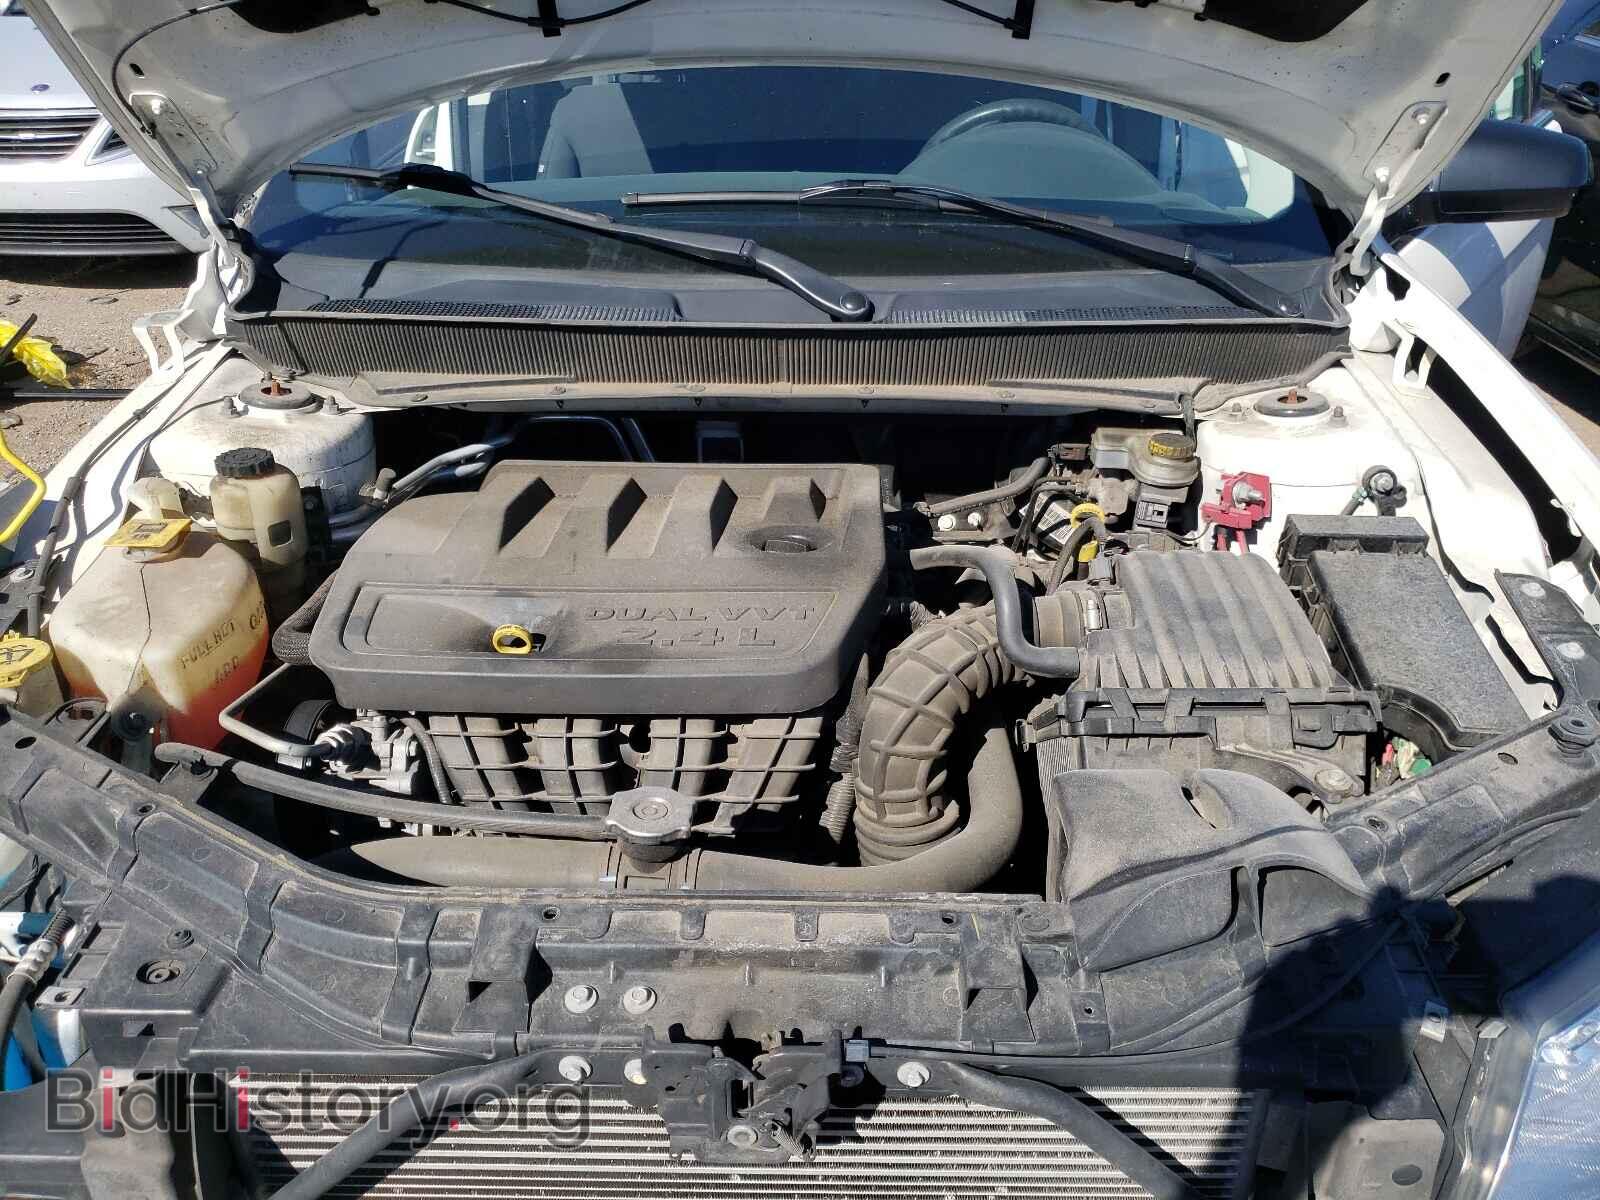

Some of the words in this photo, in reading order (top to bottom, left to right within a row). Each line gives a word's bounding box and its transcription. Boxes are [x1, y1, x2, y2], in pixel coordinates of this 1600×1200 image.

[583, 606, 707, 623] DUAL
[718, 606, 816, 623] VVT
[615, 626, 776, 648] 2.4L
